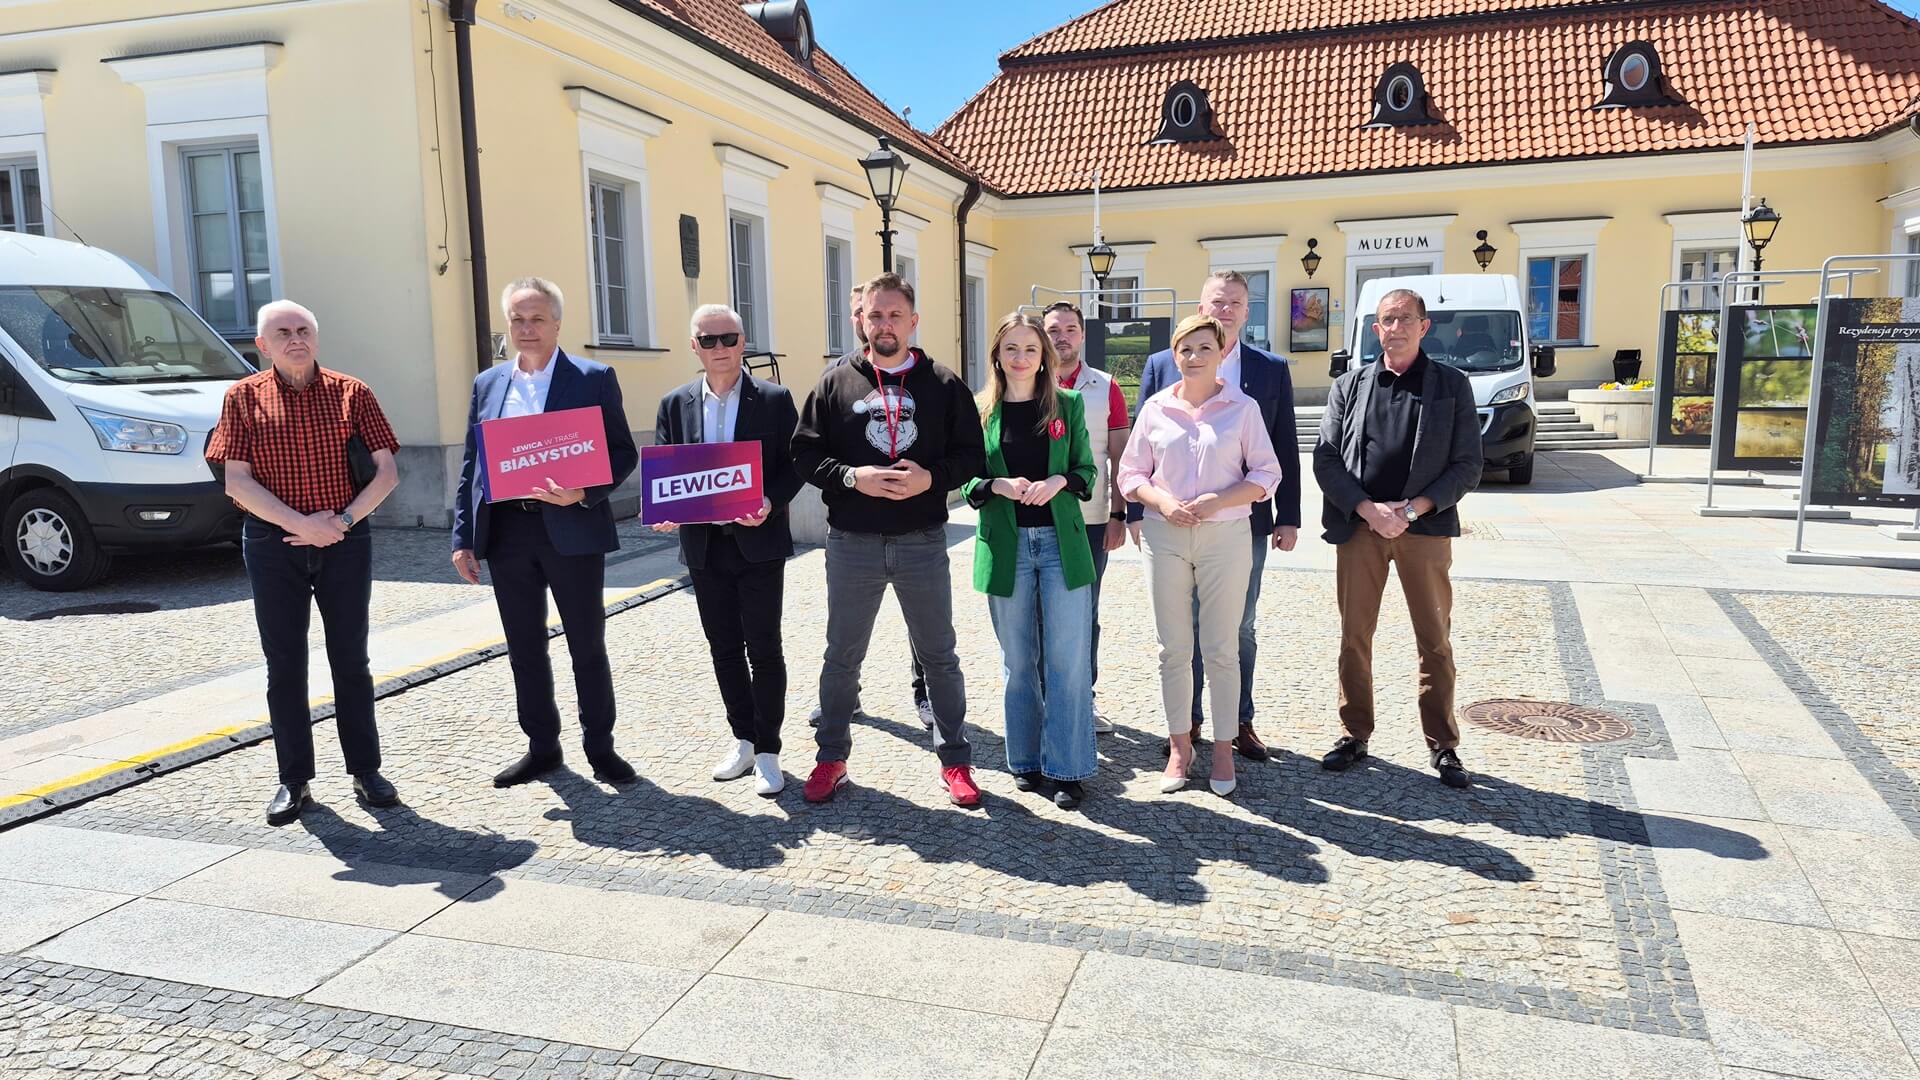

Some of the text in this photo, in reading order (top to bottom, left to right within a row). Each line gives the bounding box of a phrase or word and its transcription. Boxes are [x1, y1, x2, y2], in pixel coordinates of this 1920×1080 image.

[1358, 235, 1429, 251] MUZEUM
[1838, 325, 1920, 338] Rezydencja przyr
[512, 431, 579, 454] LEWICA W TRASIE
[499, 439, 595, 474] BIAŁYSTOK
[658, 469, 747, 498] LEWICA
